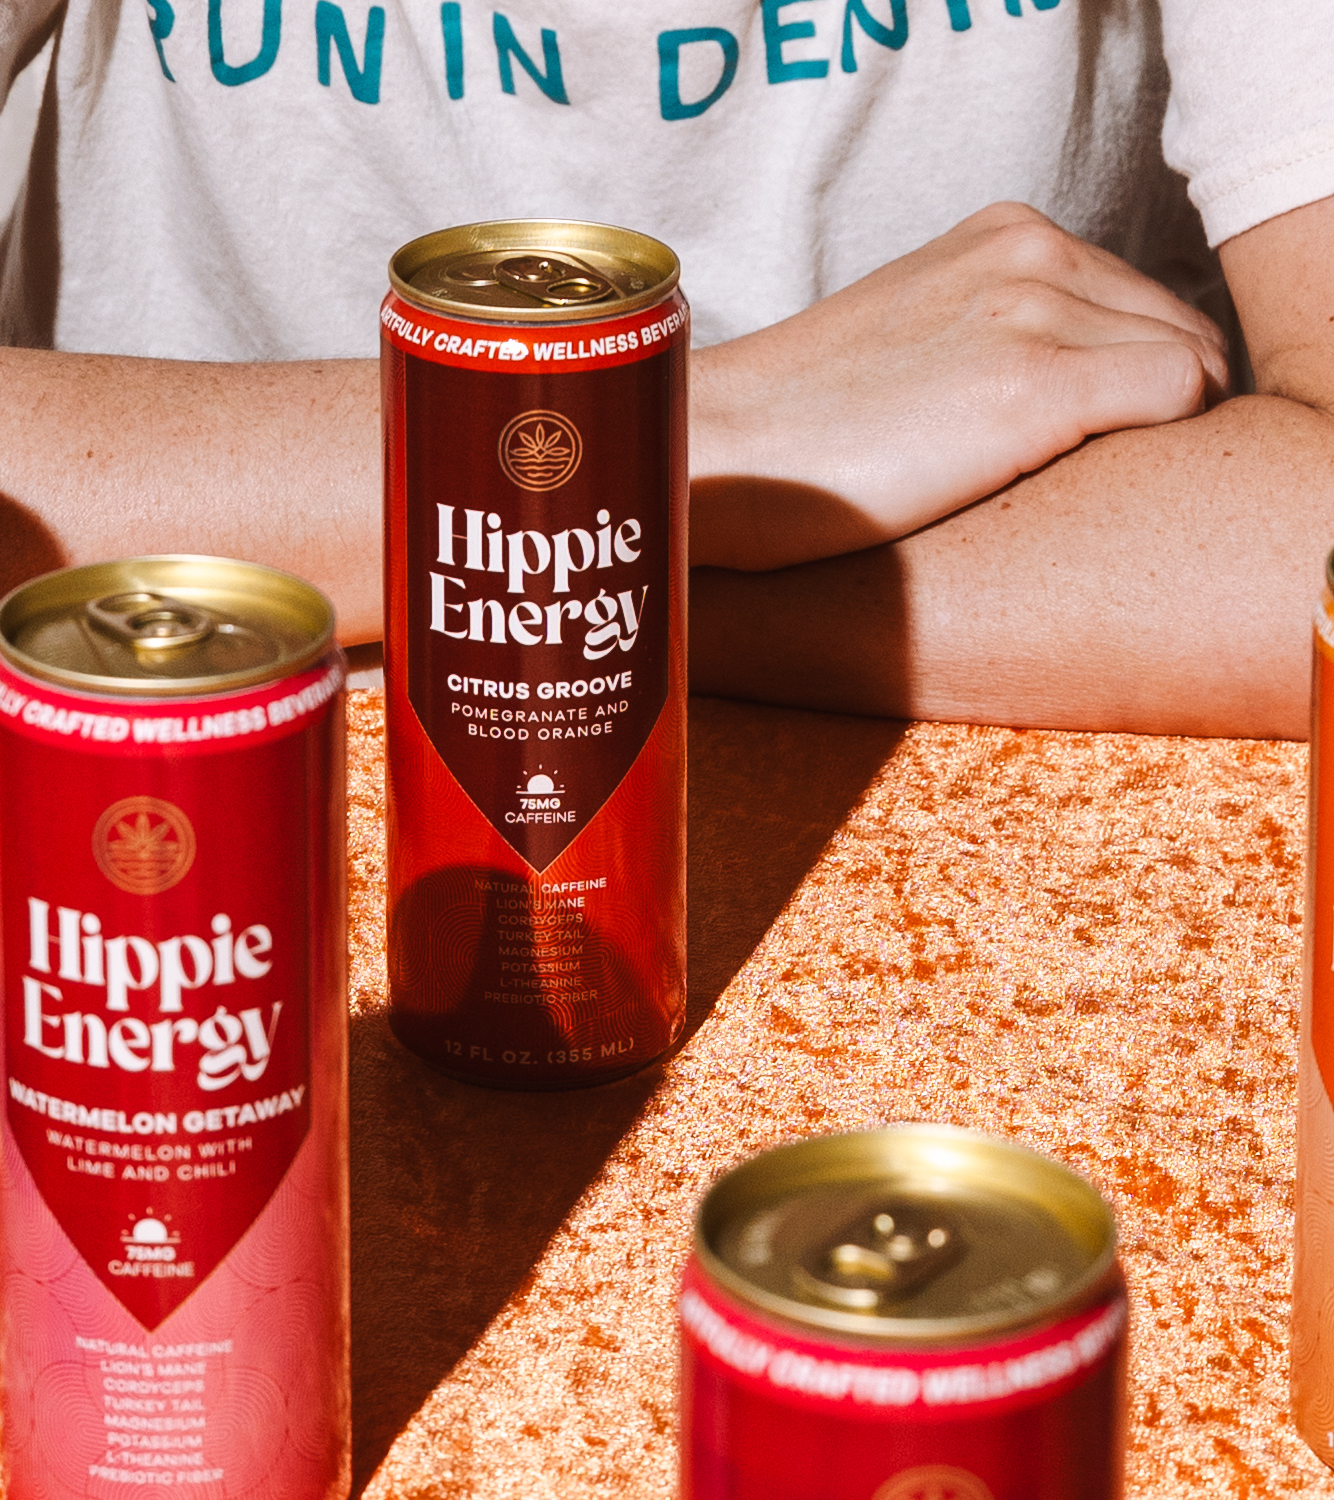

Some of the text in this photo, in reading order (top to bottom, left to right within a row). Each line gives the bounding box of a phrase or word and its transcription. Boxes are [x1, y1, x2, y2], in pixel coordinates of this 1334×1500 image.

[442, 1, 569, 105] IN
[433, 333, 528, 360] CRAFTED
[532, 325, 639, 360] WELLNESS
[436, 503, 642, 593] Hippie
[429, 572, 648, 659] Energy
[447, 670, 633, 700] CITRUS GROOVE
[451, 700, 629, 723] POMEGRANATE AND
[467, 721, 614, 741] BLOOD ORANGE
[504, 810, 576, 824] CAFFEINE
[519, 798, 560, 810] 75MG
[28, 897, 273, 1012] Hippie
[23, 975, 283, 1092] Energy
[9, 1078, 305, 1134] WATERMELON GETAWAY
